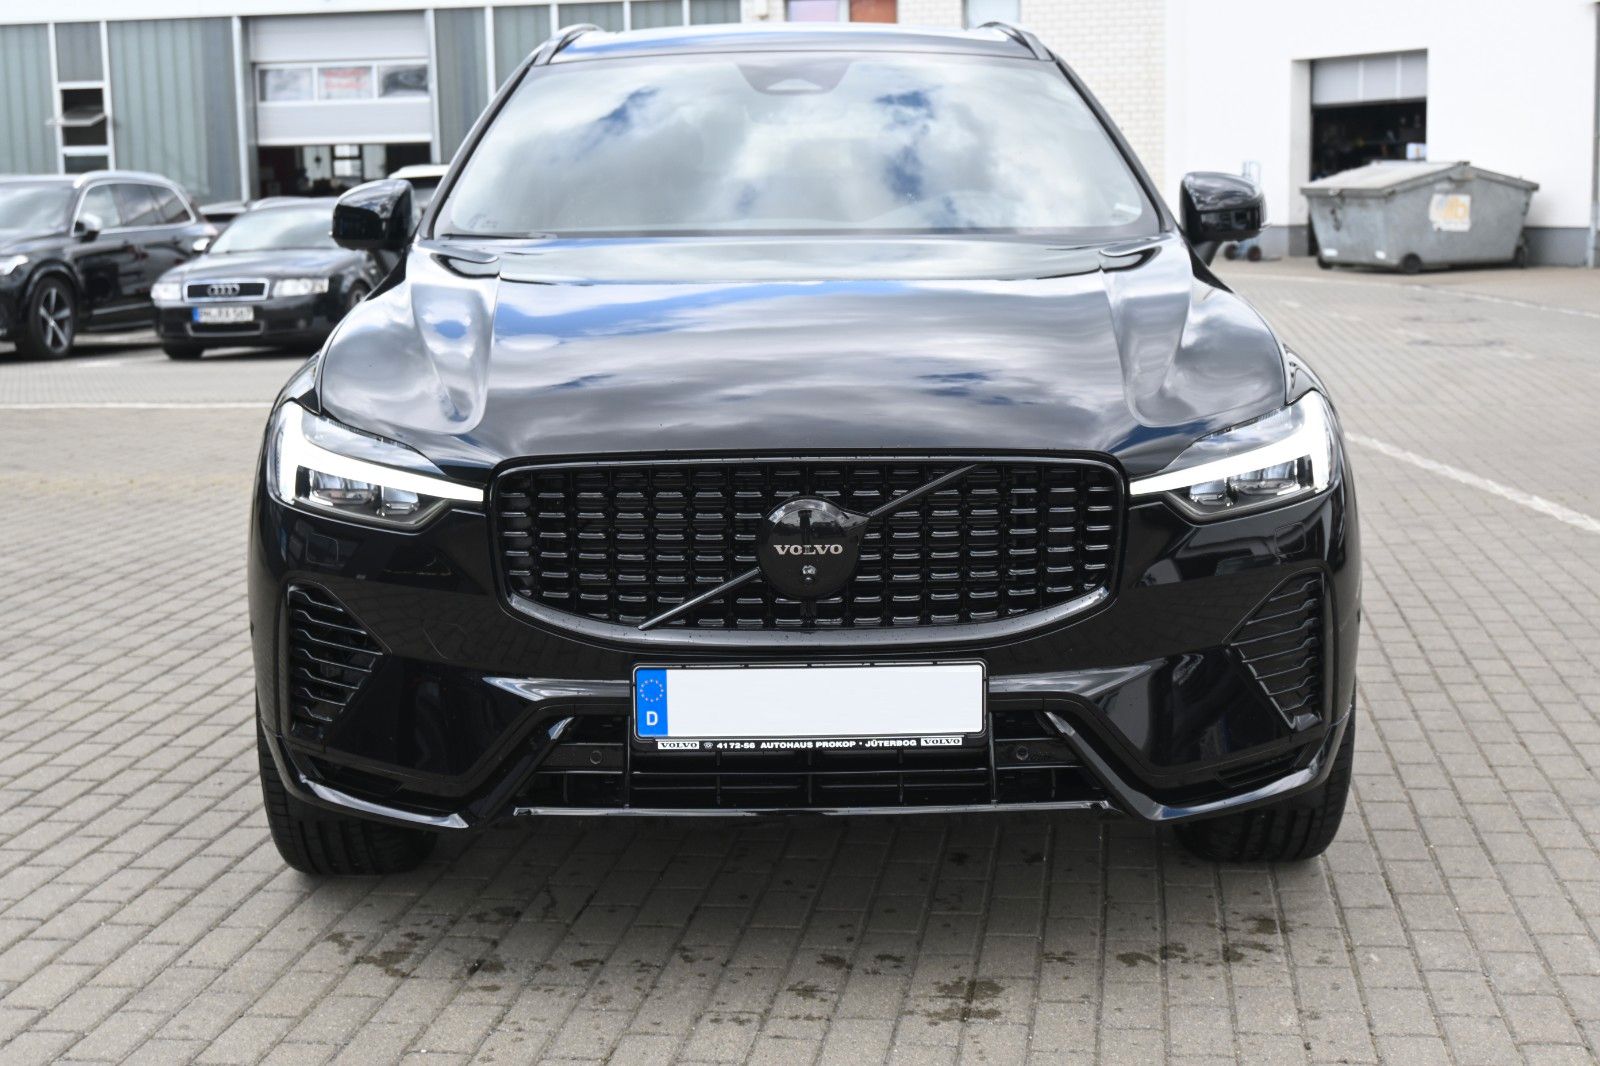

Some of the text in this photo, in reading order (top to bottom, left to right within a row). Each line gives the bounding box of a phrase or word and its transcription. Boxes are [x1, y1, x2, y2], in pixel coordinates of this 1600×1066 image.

[773, 544, 844, 556] VOLVO
[646, 710, 658, 726] D
[760, 741, 813, 749] AUTOHAUS
[815, 740, 857, 748] PROKOP
[864, 739, 918, 748] JÜTERBOG
